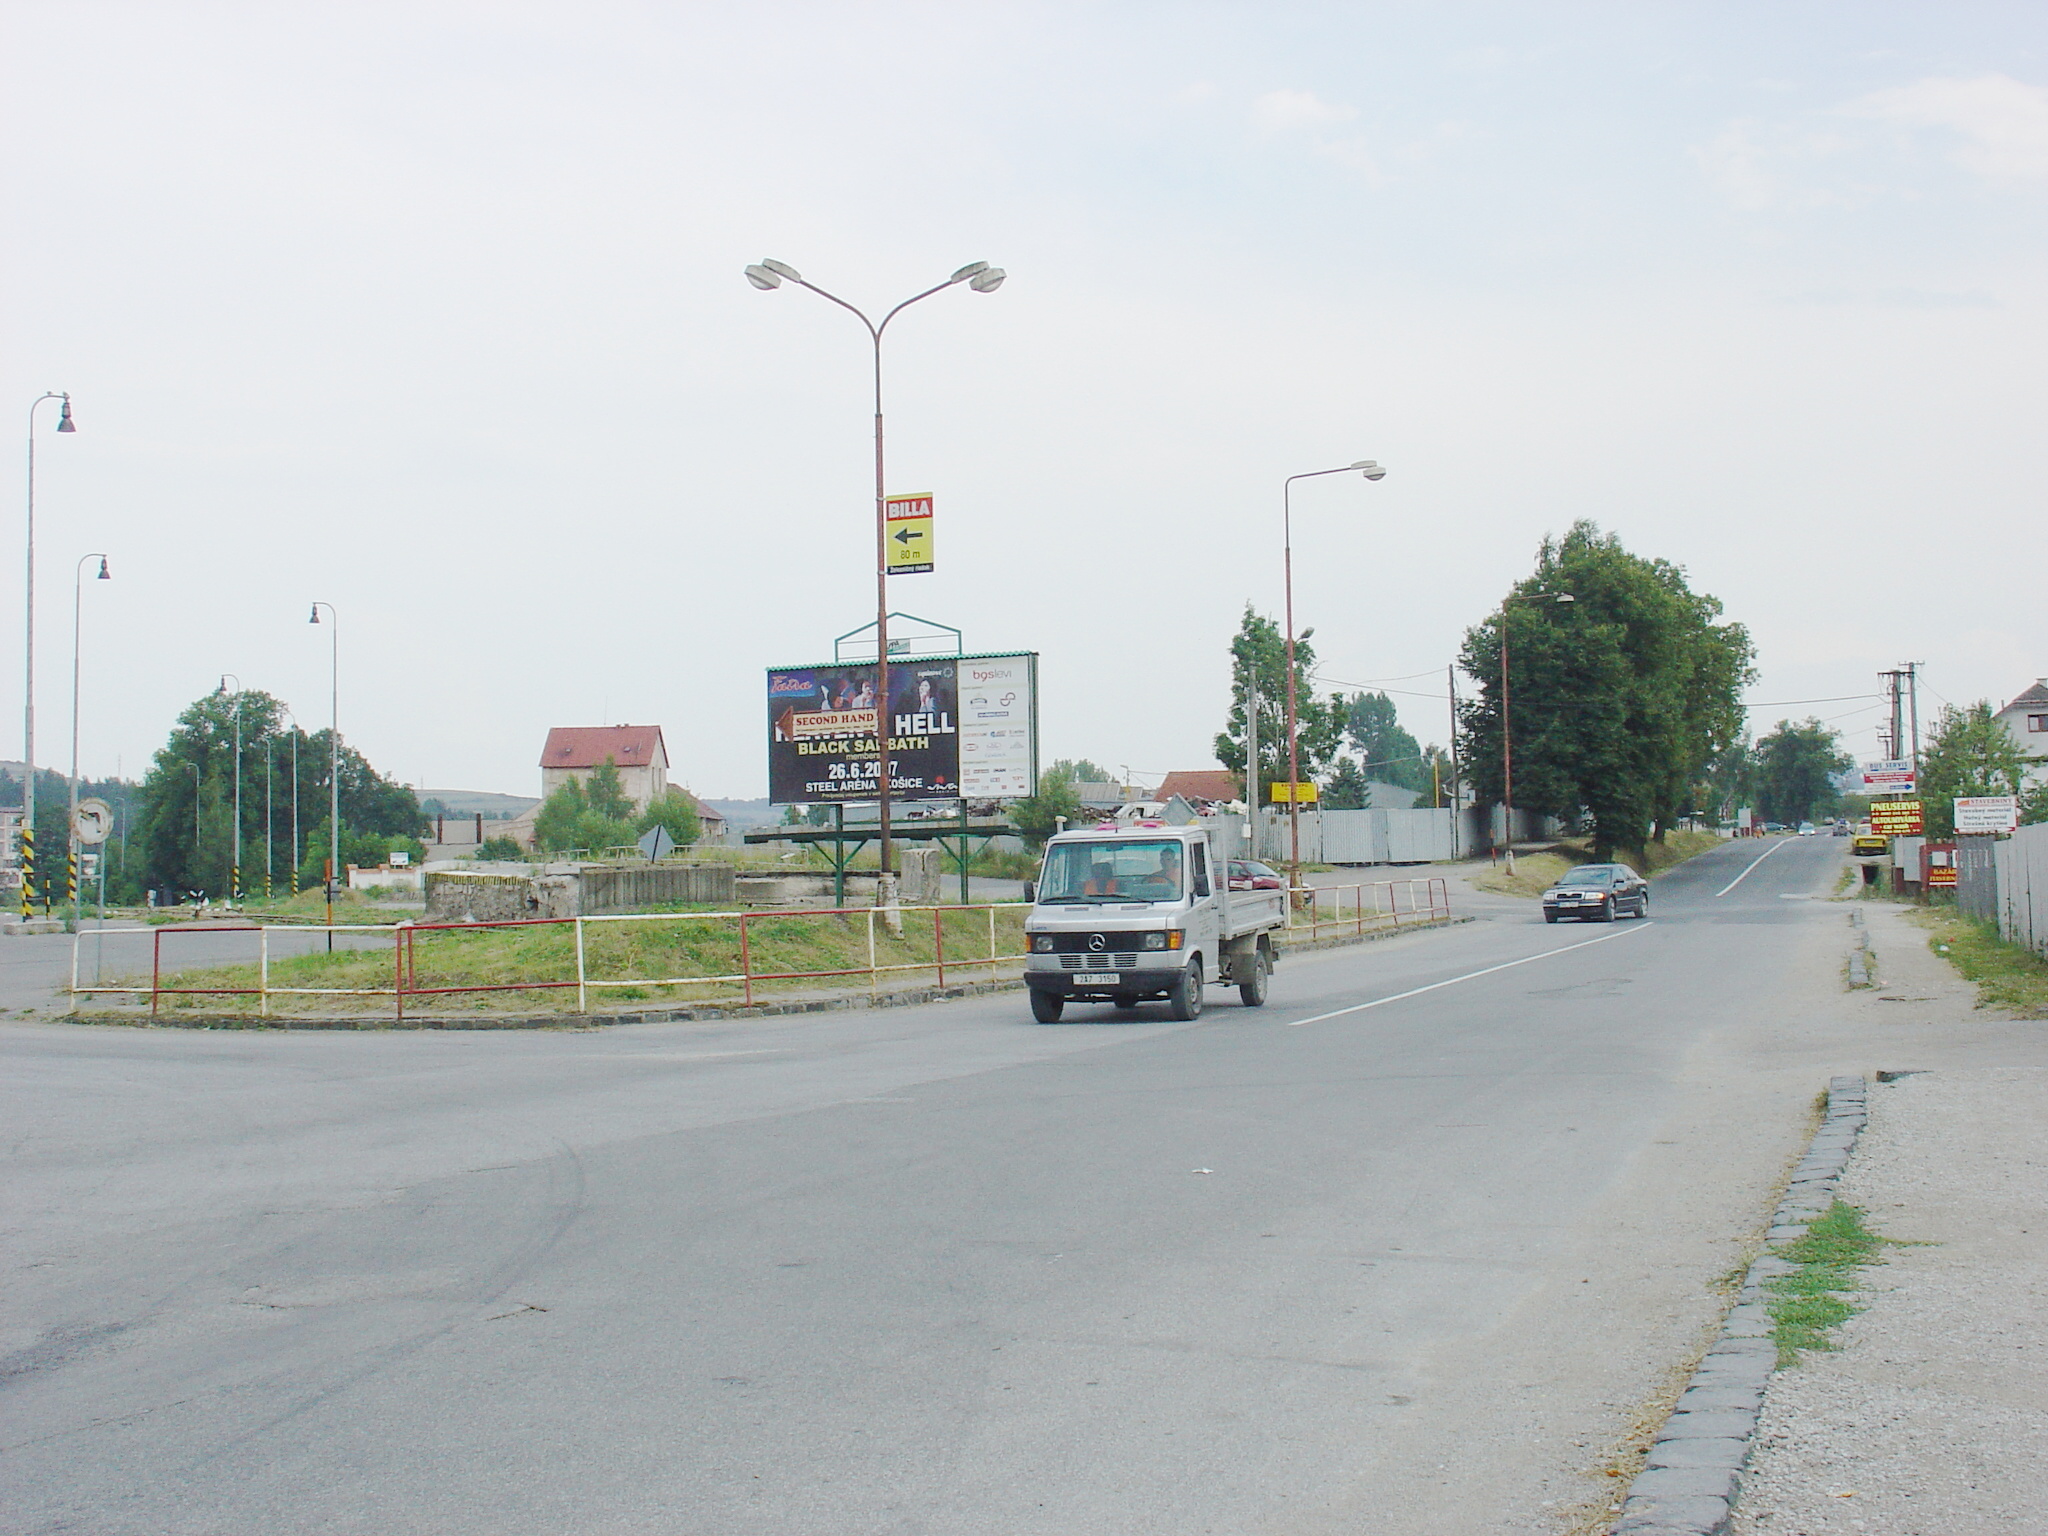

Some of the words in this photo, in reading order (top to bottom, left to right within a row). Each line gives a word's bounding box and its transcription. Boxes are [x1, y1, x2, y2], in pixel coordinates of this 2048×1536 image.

[888, 500, 930, 518] BILLA
[796, 715, 837, 725] SECOND
[842, 713, 874, 723] HAND
[895, 712, 955, 735] HELL
[798, 741, 850, 755] BLACK
[805, 782, 838, 792] STEEL
[840, 778, 876, 790] ARÉNA
[1870, 801, 1920, 811] PNEUSERVIS
